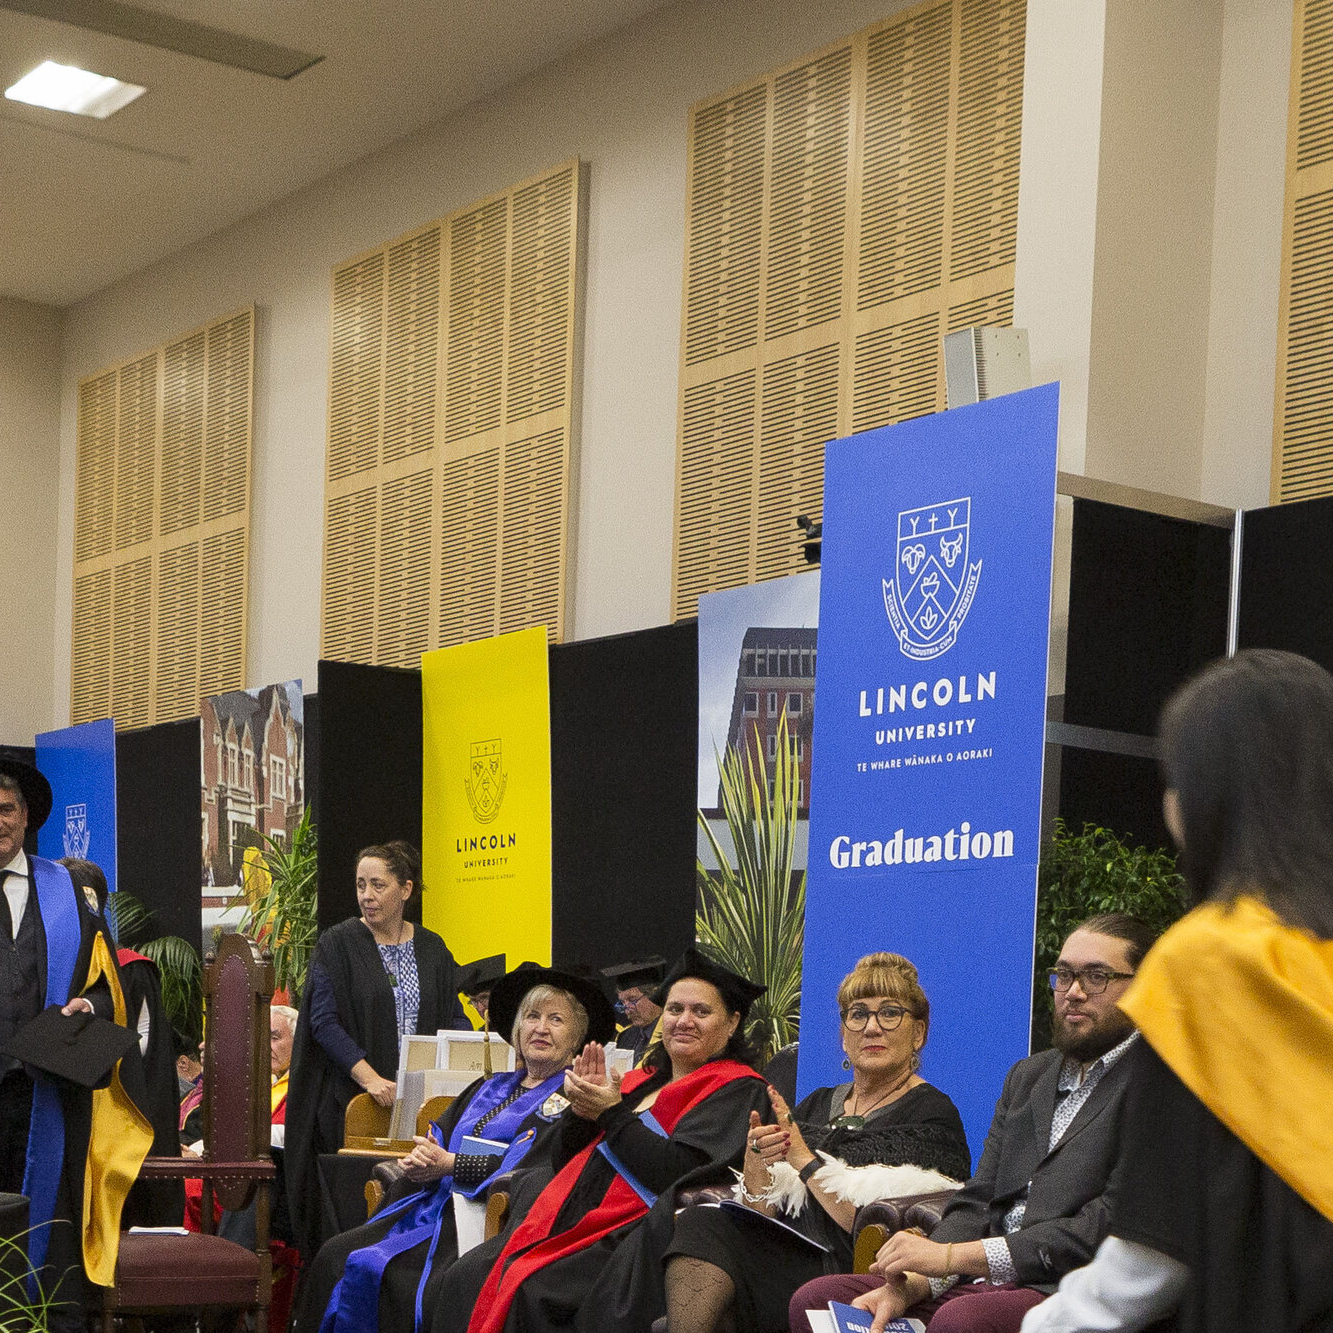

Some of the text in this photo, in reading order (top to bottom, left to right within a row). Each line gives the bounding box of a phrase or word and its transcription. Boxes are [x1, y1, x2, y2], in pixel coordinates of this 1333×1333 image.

[859, 671, 996, 717] LINCOLN
[875, 718, 976, 745] UNIVERSITY
[857, 762, 867, 772] TE
[871, 758, 902, 770] WHARE
[946, 753, 953, 762] O
[956, 748, 993, 761] AORAKI
[456, 833, 516, 853] LINCOLN
[829, 821, 1014, 869] Graduation
[464, 857, 508, 868] UNIVERSITY
